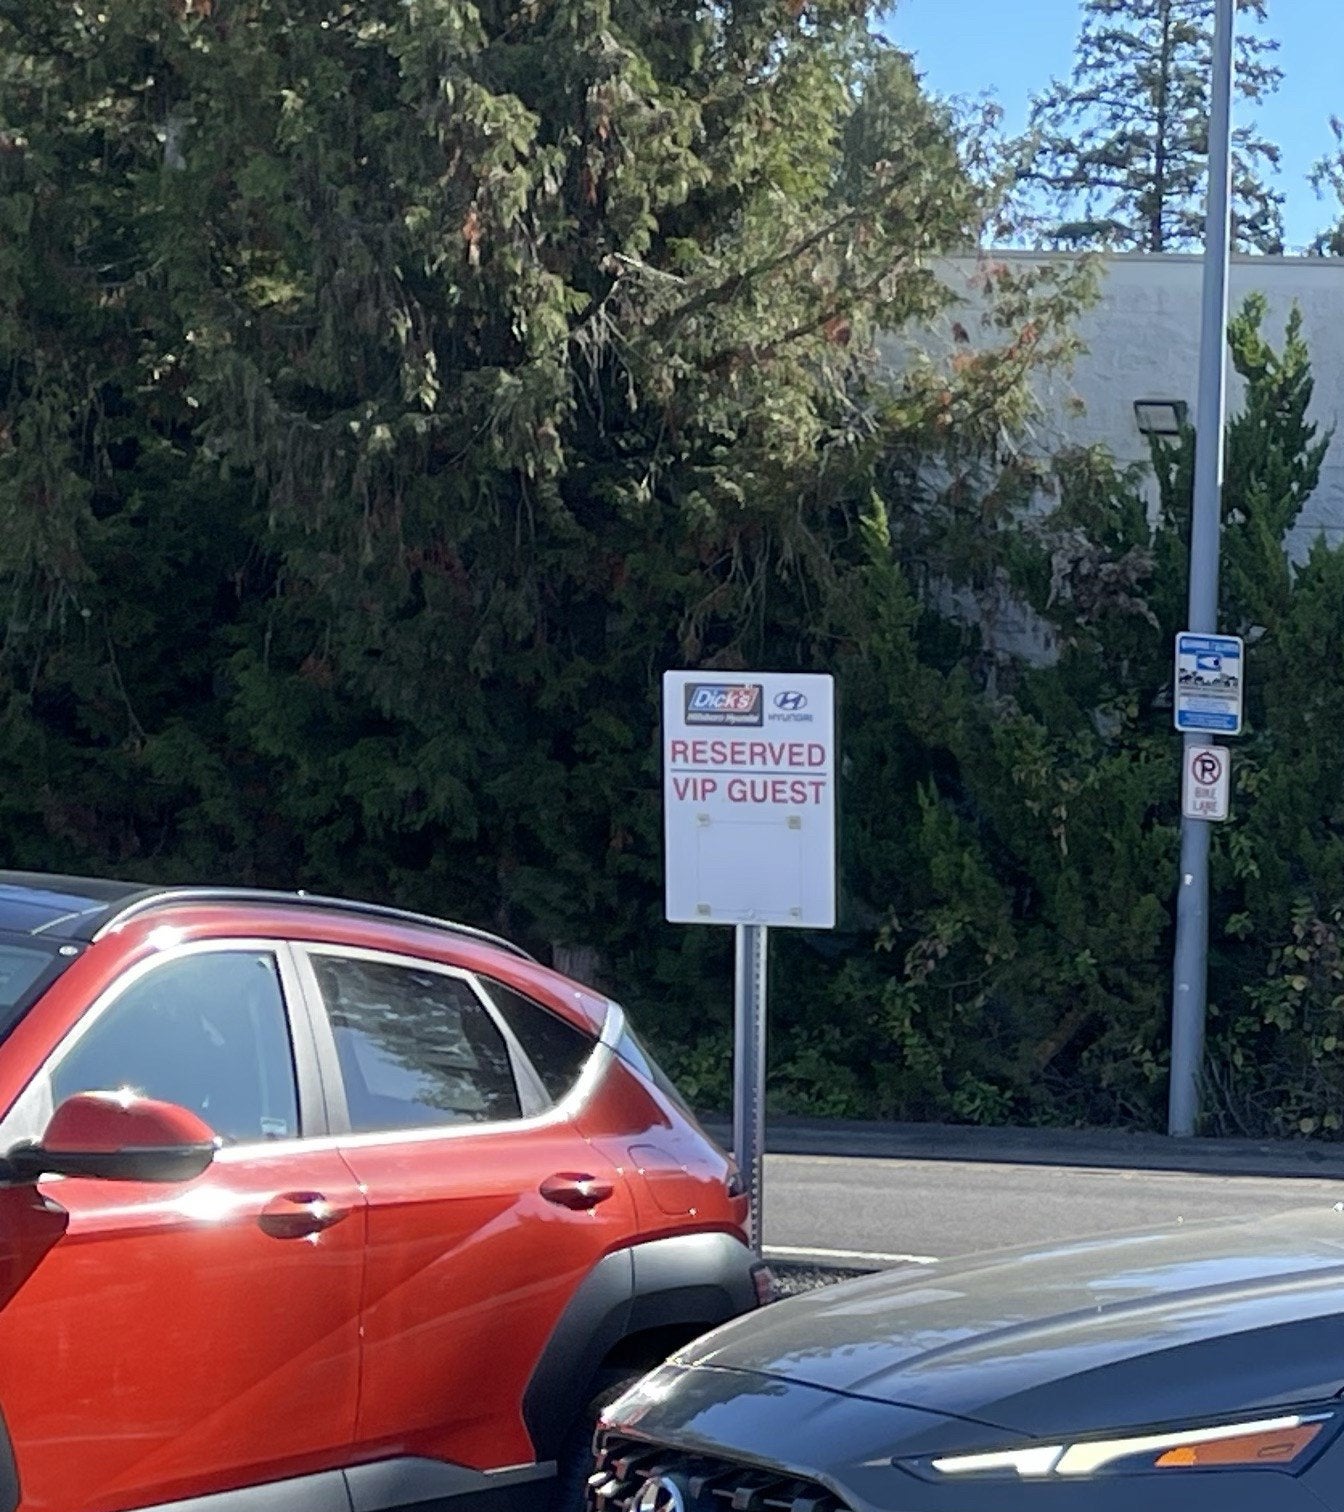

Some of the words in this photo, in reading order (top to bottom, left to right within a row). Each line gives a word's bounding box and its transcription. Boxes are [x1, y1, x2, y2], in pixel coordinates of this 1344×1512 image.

[693, 688, 751, 710] Dick's
[671, 739, 827, 767] RESERVED
[672, 777, 718, 802] VIP
[727, 778, 827, 805] GUEST
